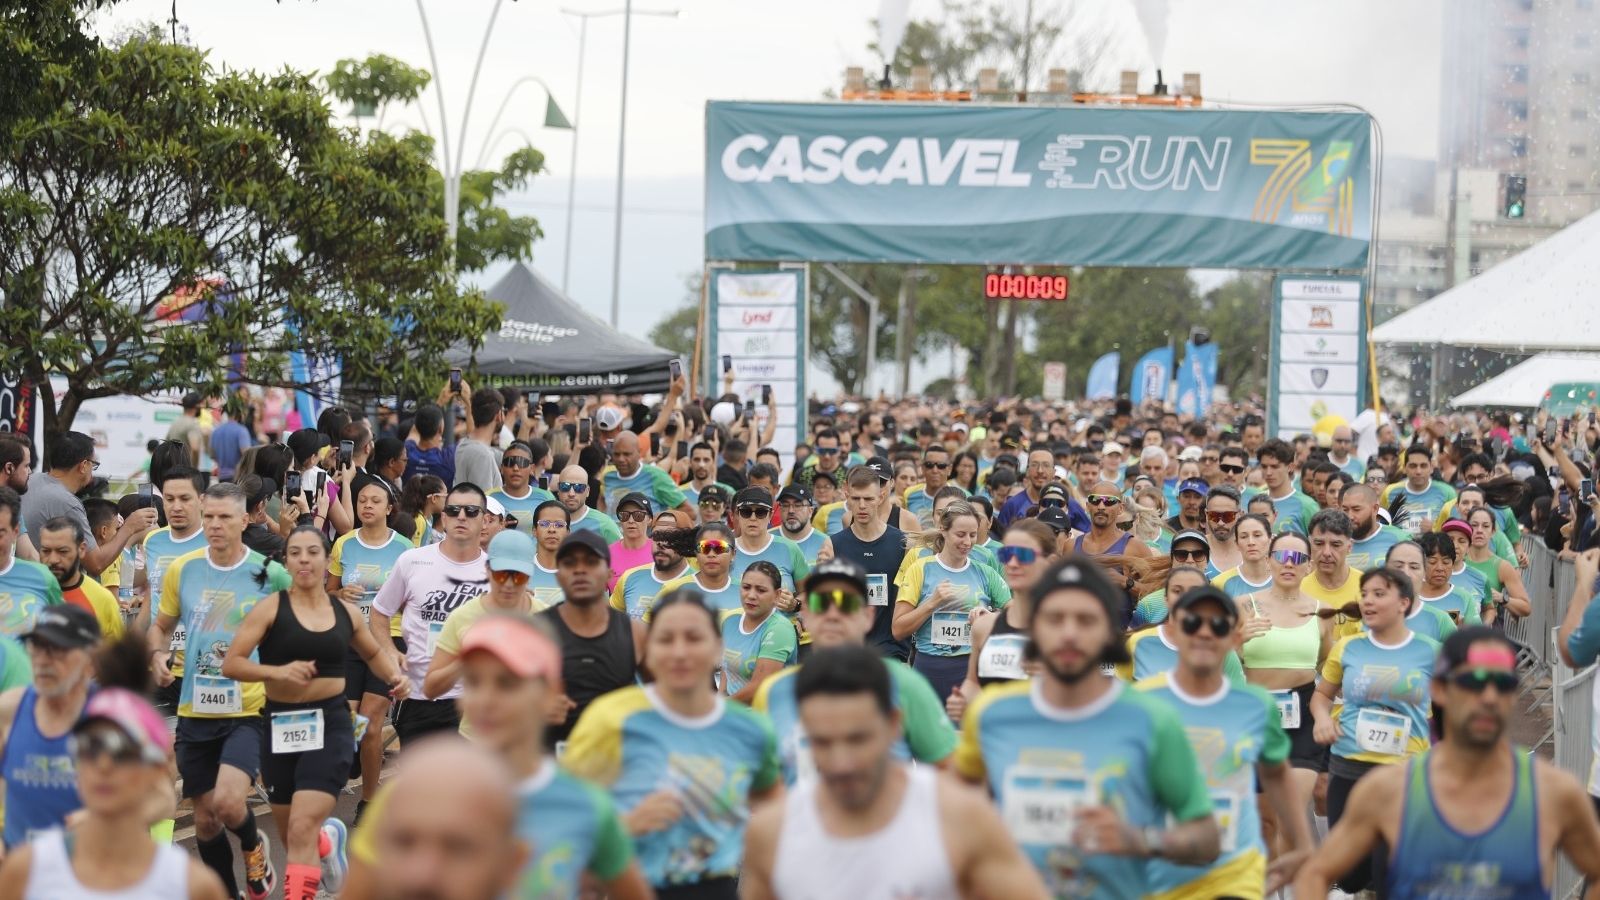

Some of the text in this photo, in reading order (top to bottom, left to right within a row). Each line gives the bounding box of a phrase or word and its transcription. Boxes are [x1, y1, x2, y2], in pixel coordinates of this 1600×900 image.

[720, 133, 1232, 191] CASCAVEL RUN
[1250, 139, 1354, 239] 74
[1291, 214, 1324, 226] anos
[986, 274, 1067, 300] 00:00:09
[420, 589, 474, 613] RU
[941, 626, 962, 637] 1421
[200, 693, 226, 705] 2440
[283, 729, 307, 743] 2152
[1368, 729, 1389, 743] 277
